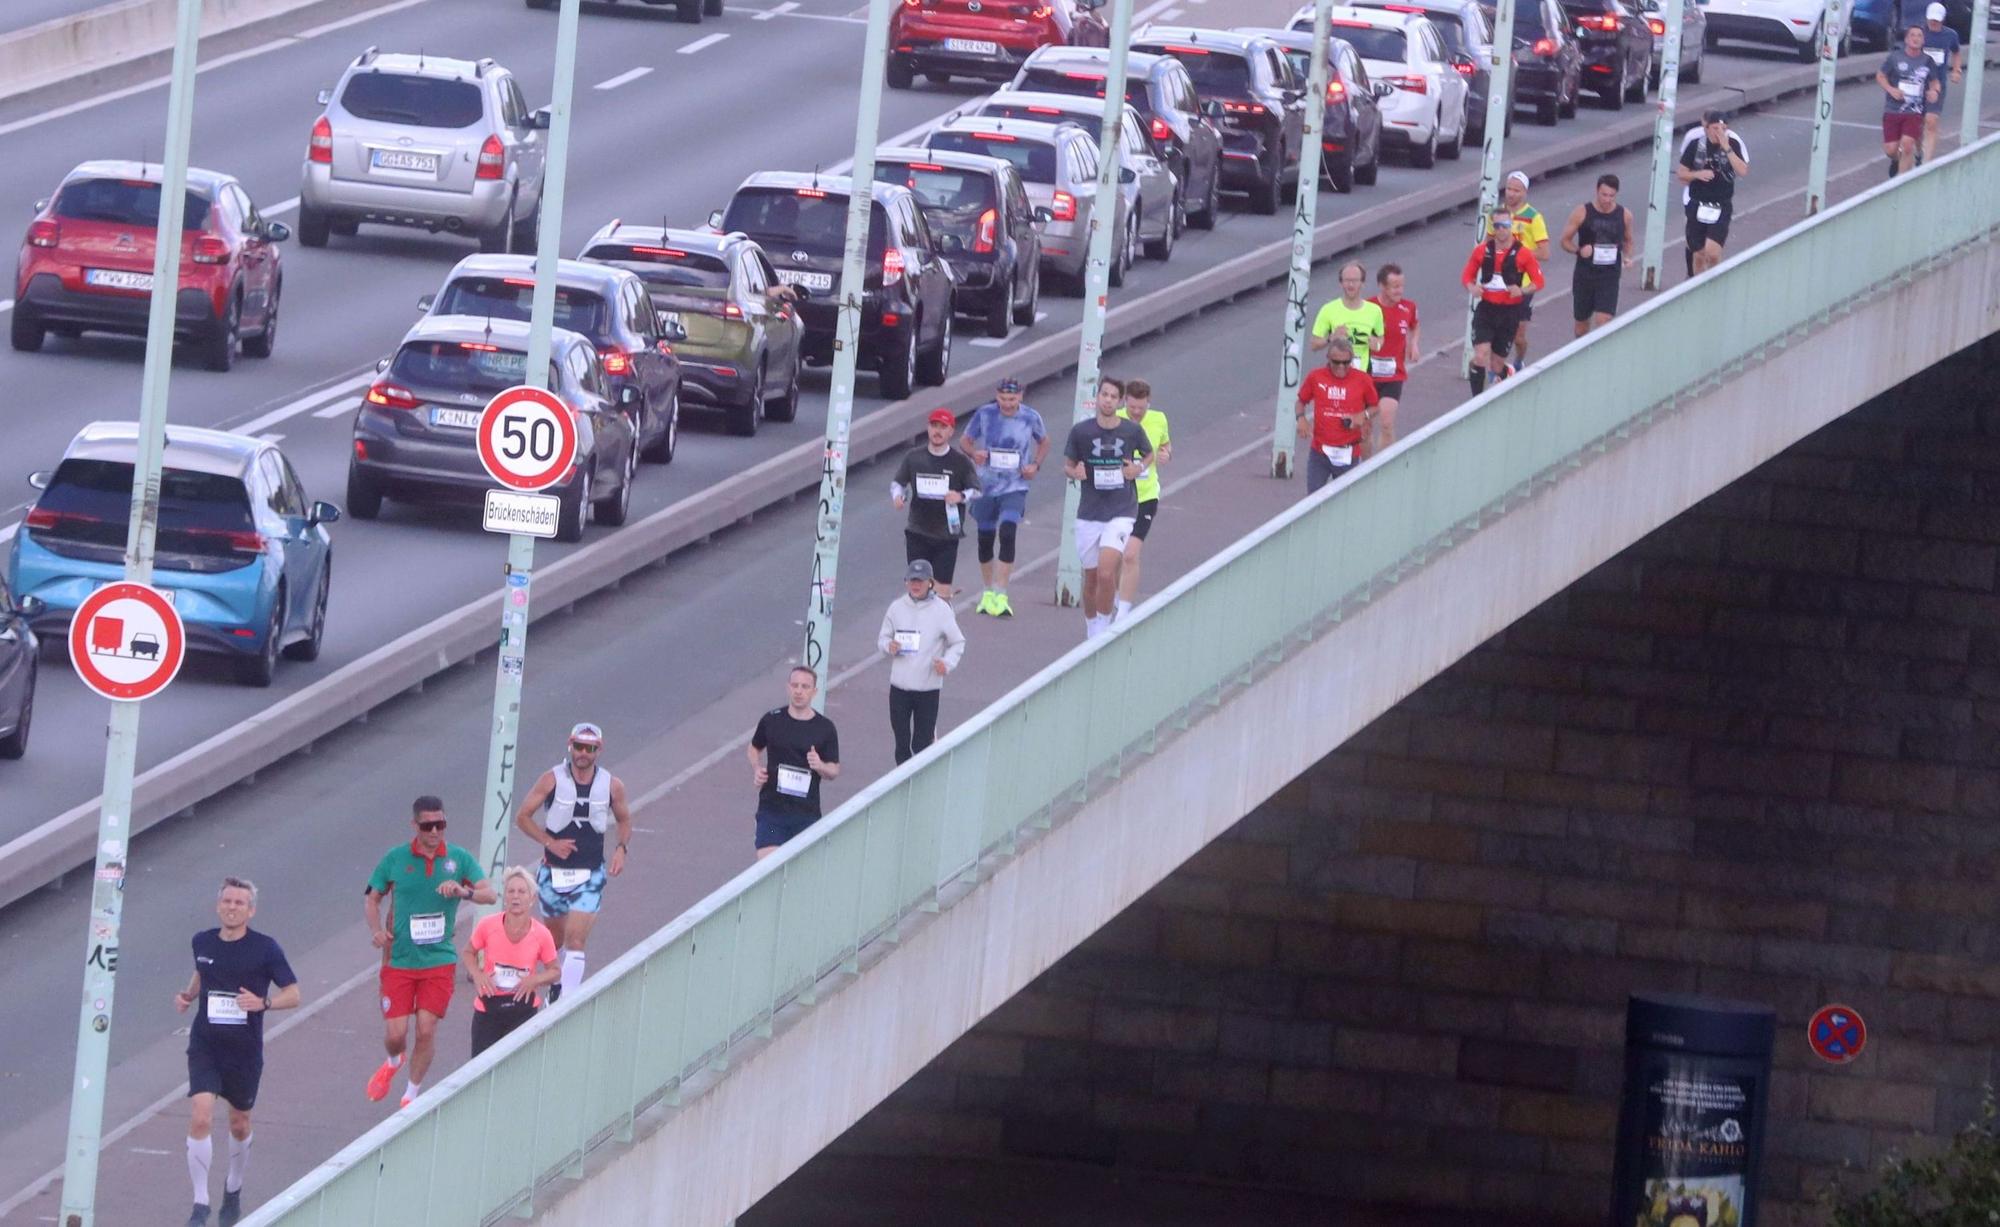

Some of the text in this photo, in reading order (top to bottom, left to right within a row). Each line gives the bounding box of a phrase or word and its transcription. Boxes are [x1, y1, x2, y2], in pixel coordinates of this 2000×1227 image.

[810, 274, 830, 288] 215
[502, 415, 555, 462] 50
[488, 502, 555, 526] Brückenschäden
